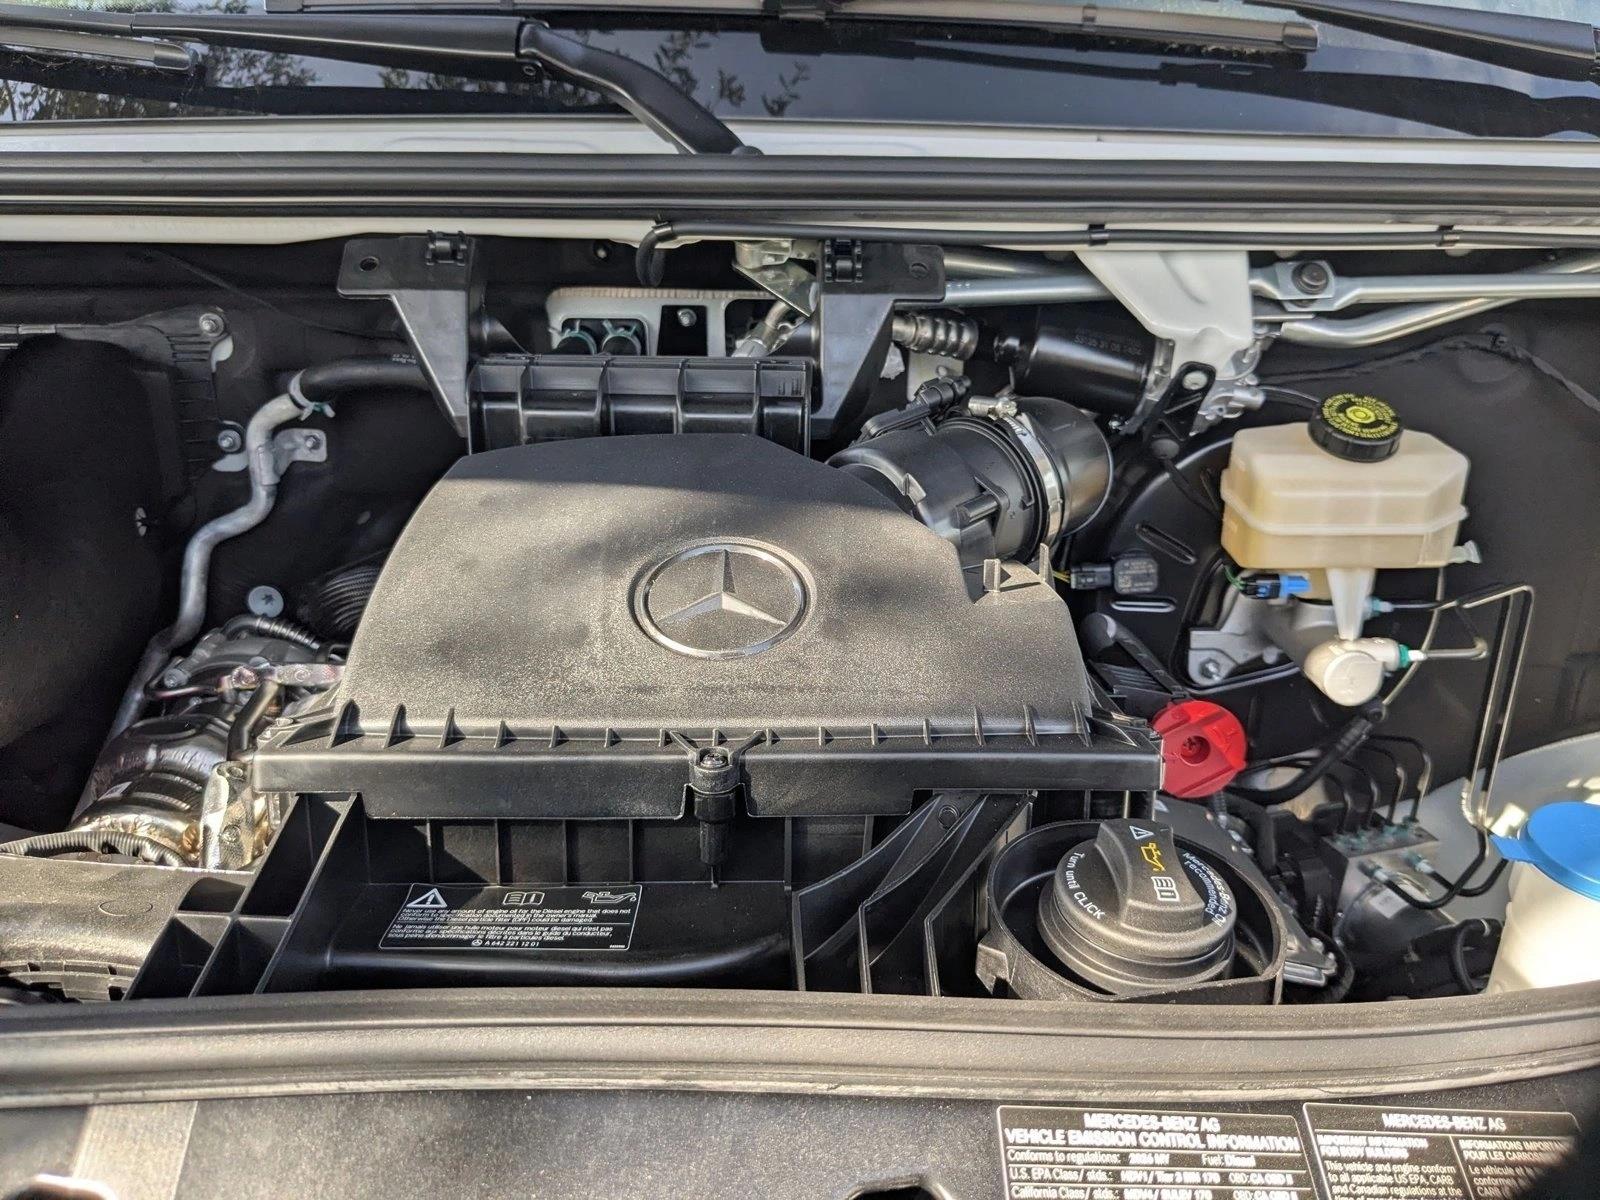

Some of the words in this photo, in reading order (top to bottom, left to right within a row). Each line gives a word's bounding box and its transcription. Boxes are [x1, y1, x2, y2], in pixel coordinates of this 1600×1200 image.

[1067, 852, 1085, 868] Turn
[1065, 870, 1080, 889] until
[1184, 860, 1219, 915] recommended
[1183, 852, 1230, 914] Mercedes-Benz
[1212, 913, 1226, 928] Oil
[1074, 892, 1105, 919] CLICK
[1083, 1112, 1199, 1132] MERCEDES-BENZ
[1200, 1117, 1221, 1132] AG
[1382, 1113, 1487, 1131] MERCEDES-BENZ
[1488, 1117, 1506, 1131] AG
[1004, 1127, 1066, 1145] VEHICLE
[1067, 1129, 1138, 1147] EMISSION
[1138, 1132, 1206, 1149] CONTROL
[1206, 1134, 1300, 1151] INFORMATION
[1458, 1139, 1523, 1150] INFORMATIONS
[1007, 1149, 1054, 1162] Conforms
[1054, 1151, 1065, 1162] to
[1066, 1151, 1120, 1165] regulations:
[1463, 1150, 1488, 1160] POUR
[1488, 1151, 1505, 1160] LES
[1009, 1167, 1031, 1180] U.S.
[1031, 1168, 1051, 1180] EPA
[1052, 1168, 1078, 1181] Class
[1324, 1160, 1344, 1172] This
[1344, 1162, 1374, 1173] vehicle
[1375, 1163, 1392, 1173] and
[1392, 1163, 1420, 1175] engine
[1421, 1164, 1456, 1174] conform
[1468, 1165, 1481, 1175] Le
[1328, 1172, 1339, 1182] to
[1340, 1172, 1350, 1182] all
[1351, 1173, 1394, 1184] applicable
[1394, 1173, 1408, 1184] US
[1408, 1174, 1429, 1186] EPA,
[1429, 1174, 1454, 1185] CARB
[1011, 1185, 1057, 1199] California
[1059, 1186, 1085, 1199] Class
[1331, 1183, 1349, 1194] and
[1349, 1184, 1389, 1195] Canadian
[1390, 1185, 1437, 1197] regulations
[1438, 1186, 1447, 1196] at
[1447, 1186, 1463, 1196] the
